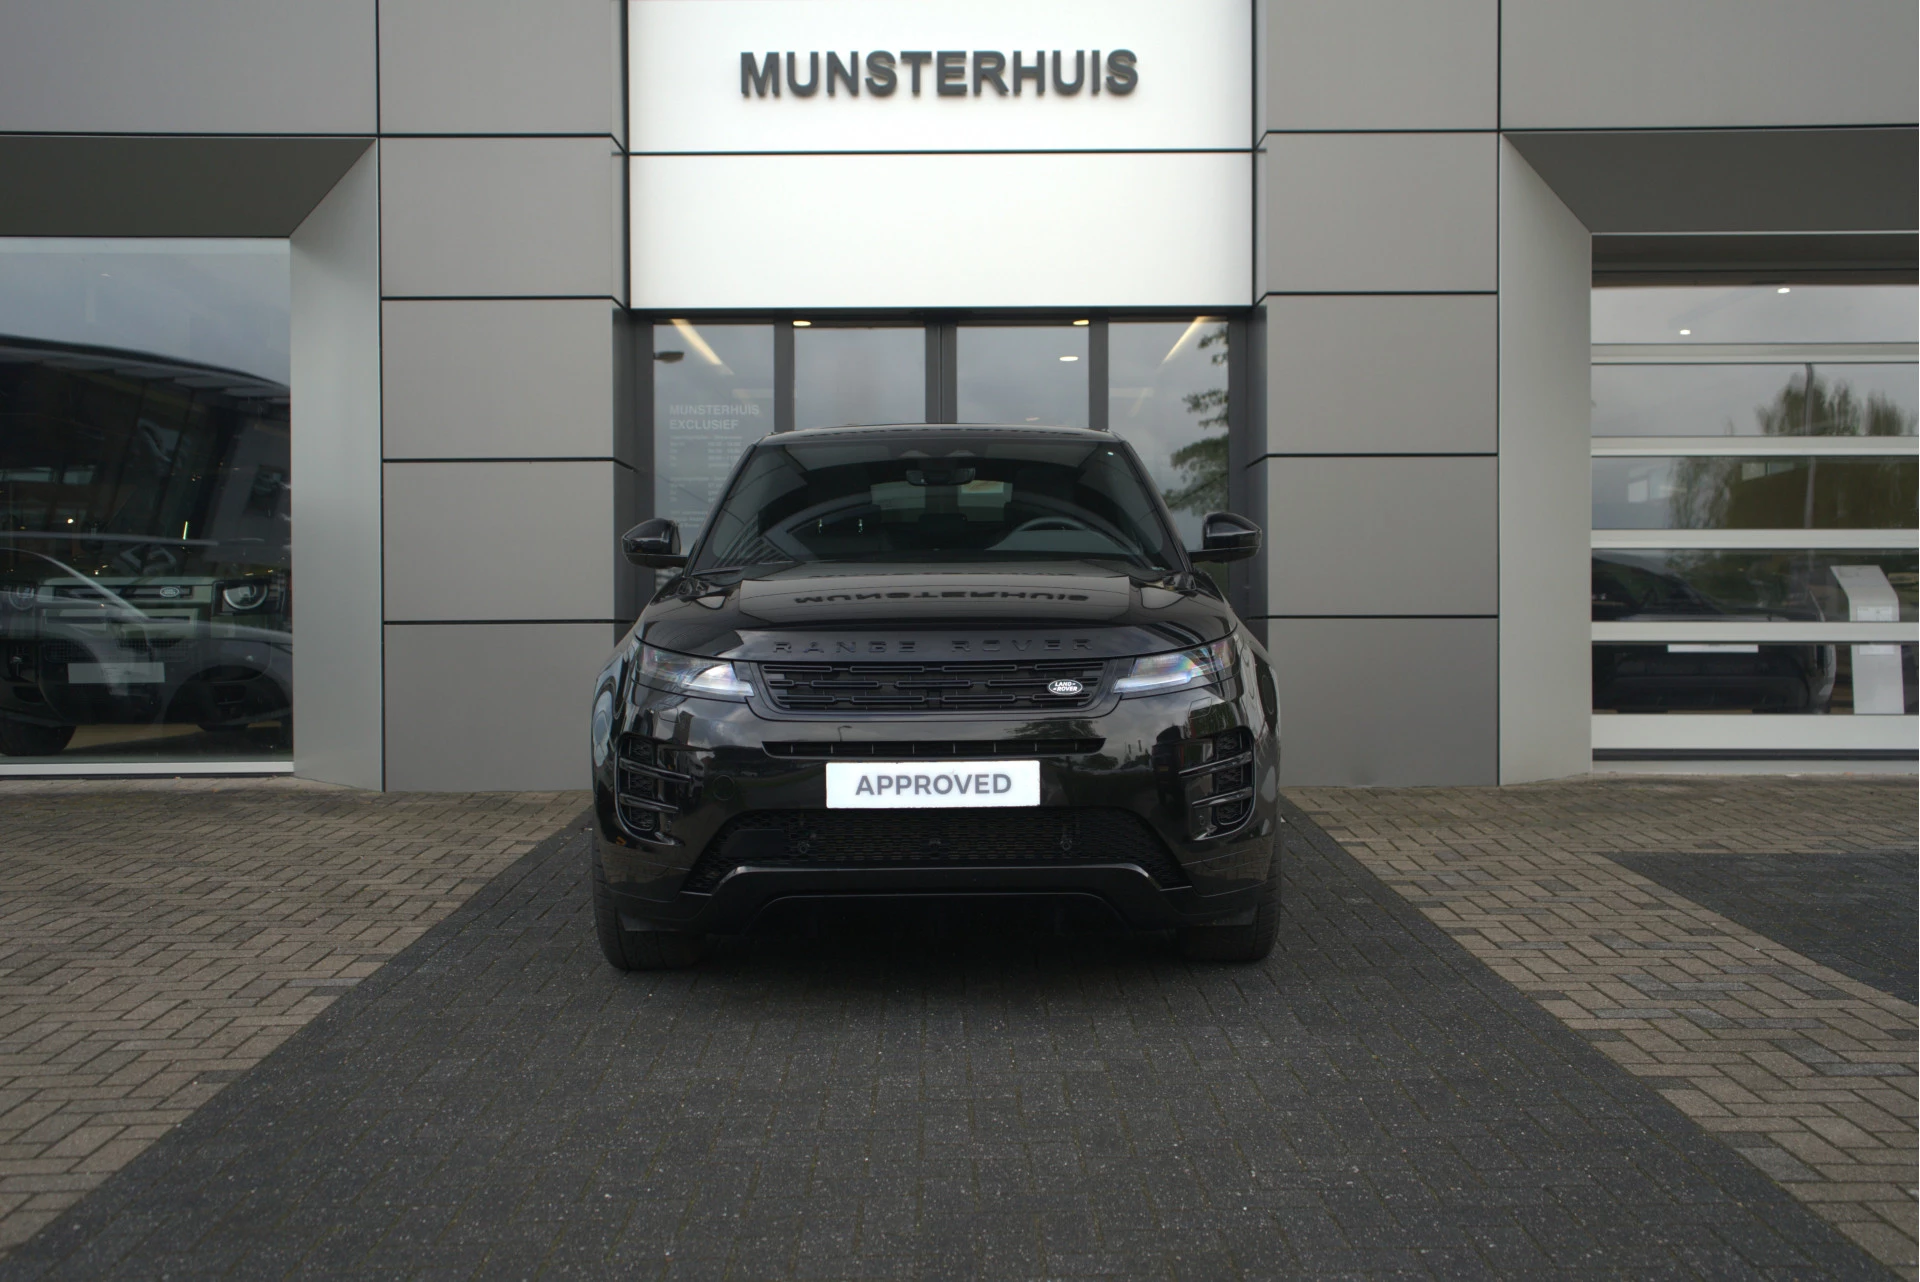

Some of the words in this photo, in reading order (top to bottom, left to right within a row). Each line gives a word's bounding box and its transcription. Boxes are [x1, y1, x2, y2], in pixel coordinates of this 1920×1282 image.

[740, 49, 1139, 98] MUNSTERHUIS
[669, 404, 760, 416] MUNSTERHUIS
[669, 419, 739, 431] EXCLUSIEF
[773, 640, 918, 654] RANGE
[951, 638, 1093, 653] ROVER
[855, 773, 1012, 796] APPROVED
